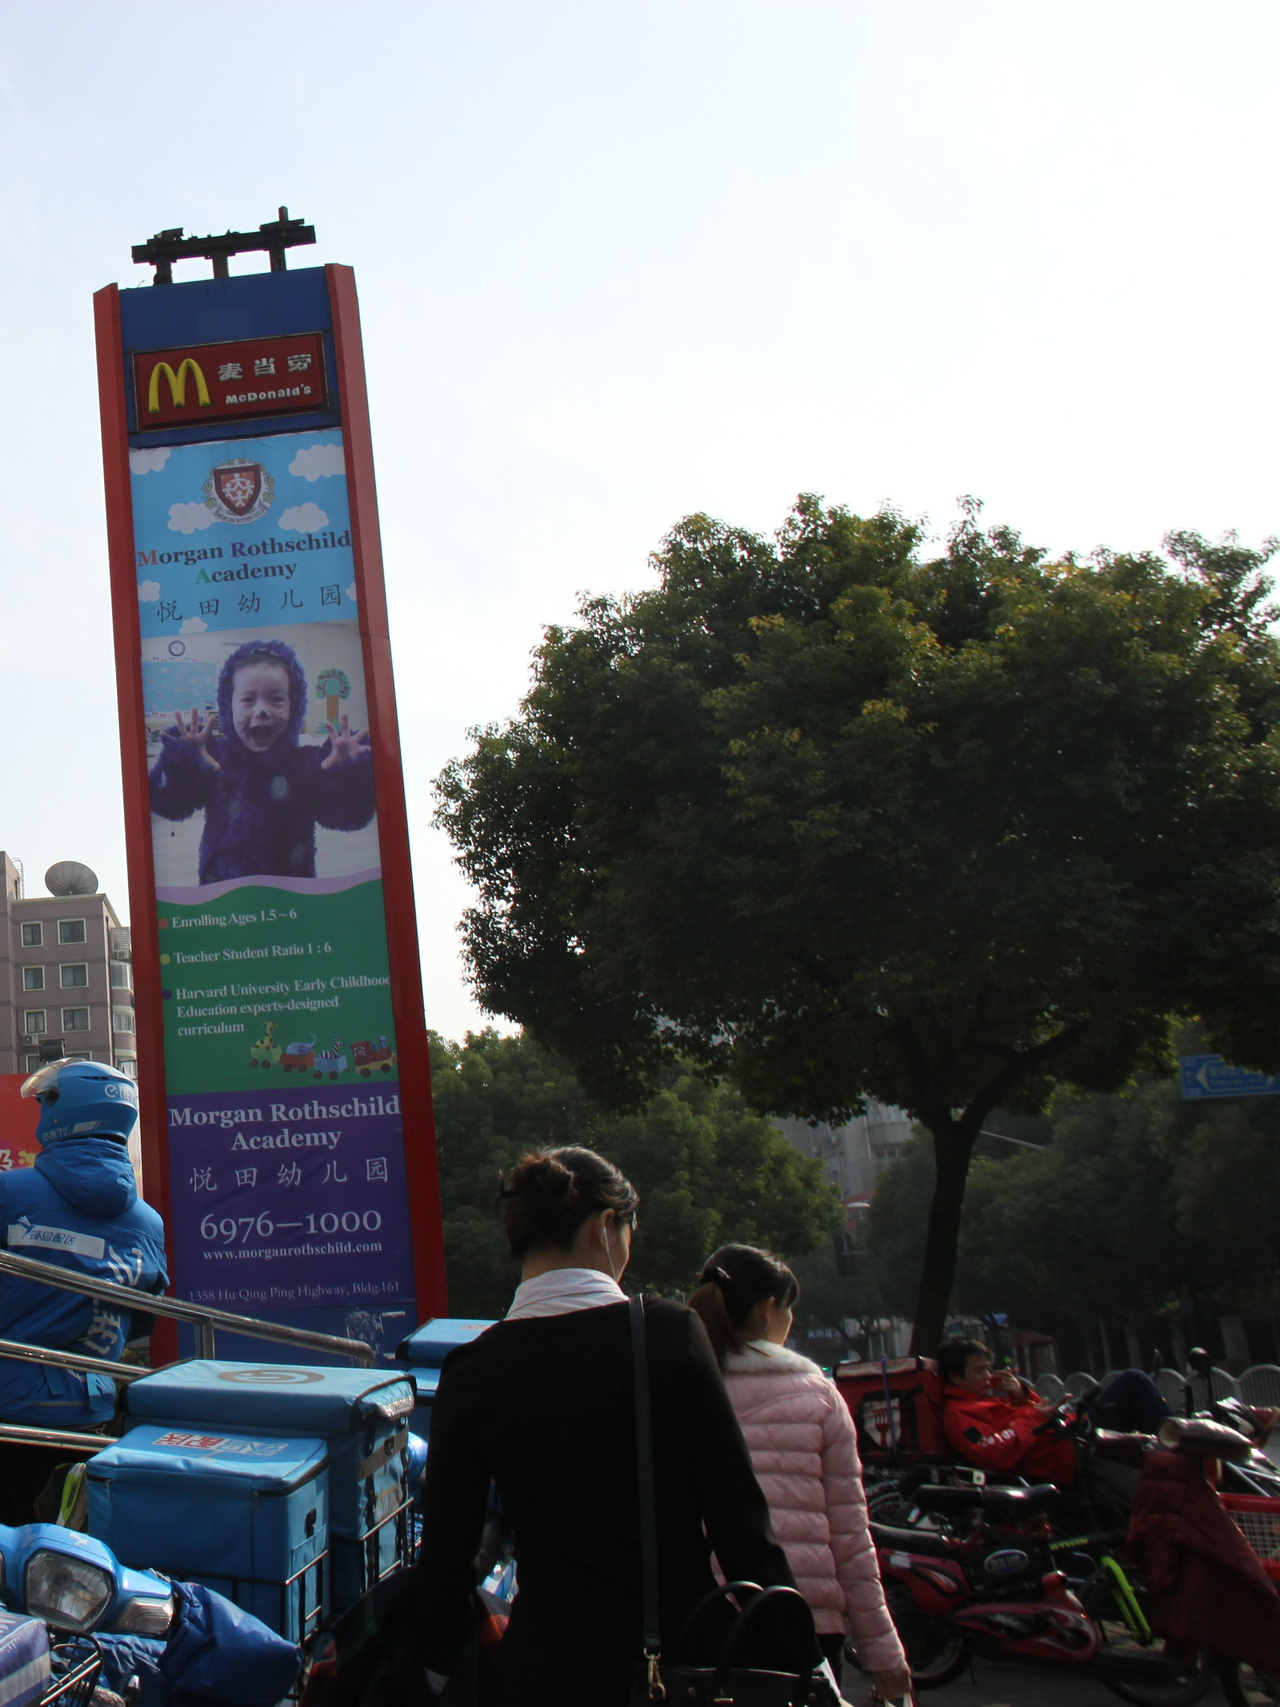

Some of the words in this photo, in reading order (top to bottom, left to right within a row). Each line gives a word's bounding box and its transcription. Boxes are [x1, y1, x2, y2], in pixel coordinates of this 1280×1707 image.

[218, 354, 312, 382] 麦当劳
[226, 384, 312, 405] McDonald's
[137, 546, 223, 566] Morgan
[230, 530, 352, 558] Rothschild
[194, 563, 297, 585] Academy
[157, 584, 342, 623] 悦田幼儿园
[172, 912, 226, 928] Enrolling
[228, 912, 257, 926] Ages
[174, 951, 220, 964] Teacher
[223, 947, 269, 961] Student
[272, 944, 304, 957] Ratio
[176, 985, 228, 1000] Harvard
[230, 981, 291, 998] University
[294, 979, 327, 994] Early
[177, 1003, 238, 1018] Education
[240, 996, 339, 1016] experts-designed
[177, 1022, 245, 1036] curriculum
[170, 1107, 263, 1128] Morgan
[270, 1095, 401, 1122] Rothschild
[231, 1128, 342, 1151] Academy
[189, 1156, 388, 1193] 悦田幼儿园
[28, 1229, 77, 1246] 蜂鸟配送
[203, 1241, 382, 1261] www.morganrothschild.com
[189, 1290, 215, 1302] 1358
[219, 1289, 236, 1300] Hu
[239, 1288, 268, 1302] Qing
[270, 1287, 295, 1300] Ping
[298, 1285, 350, 1298] Highway,
